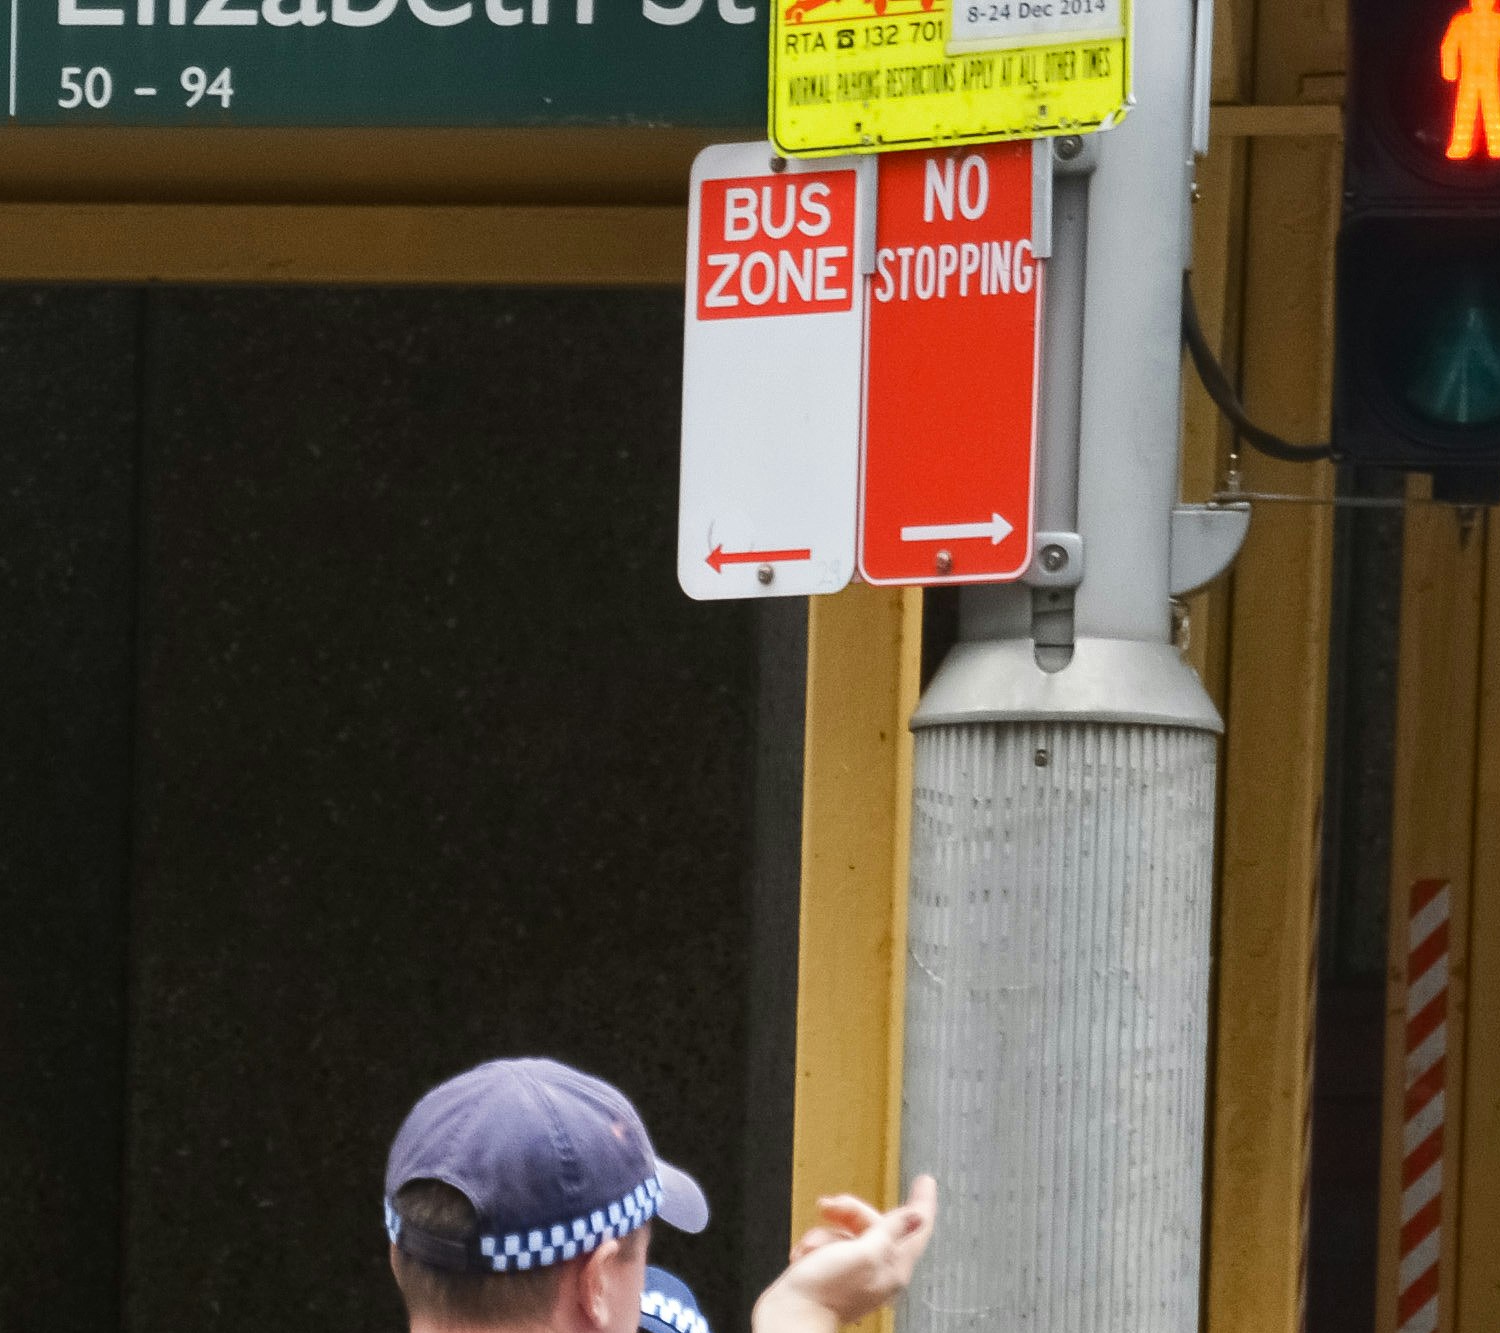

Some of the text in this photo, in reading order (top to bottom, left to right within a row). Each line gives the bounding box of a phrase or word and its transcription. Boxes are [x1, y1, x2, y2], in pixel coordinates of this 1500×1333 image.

[785, 20, 944, 54] RTA 132 701
[967, 3, 1011, 23] 8-24
[1018, 2, 1052, 19] Dec
[58, 66, 113, 108] 50
[180, 66, 234, 108] 94
[886, 62, 957, 98] RESTRICTIONS
[723, 181, 832, 243] BUS
[923, 154, 990, 223] NO
[704, 245, 849, 309] ZONE
[873, 238, 1035, 303] STOPPING
